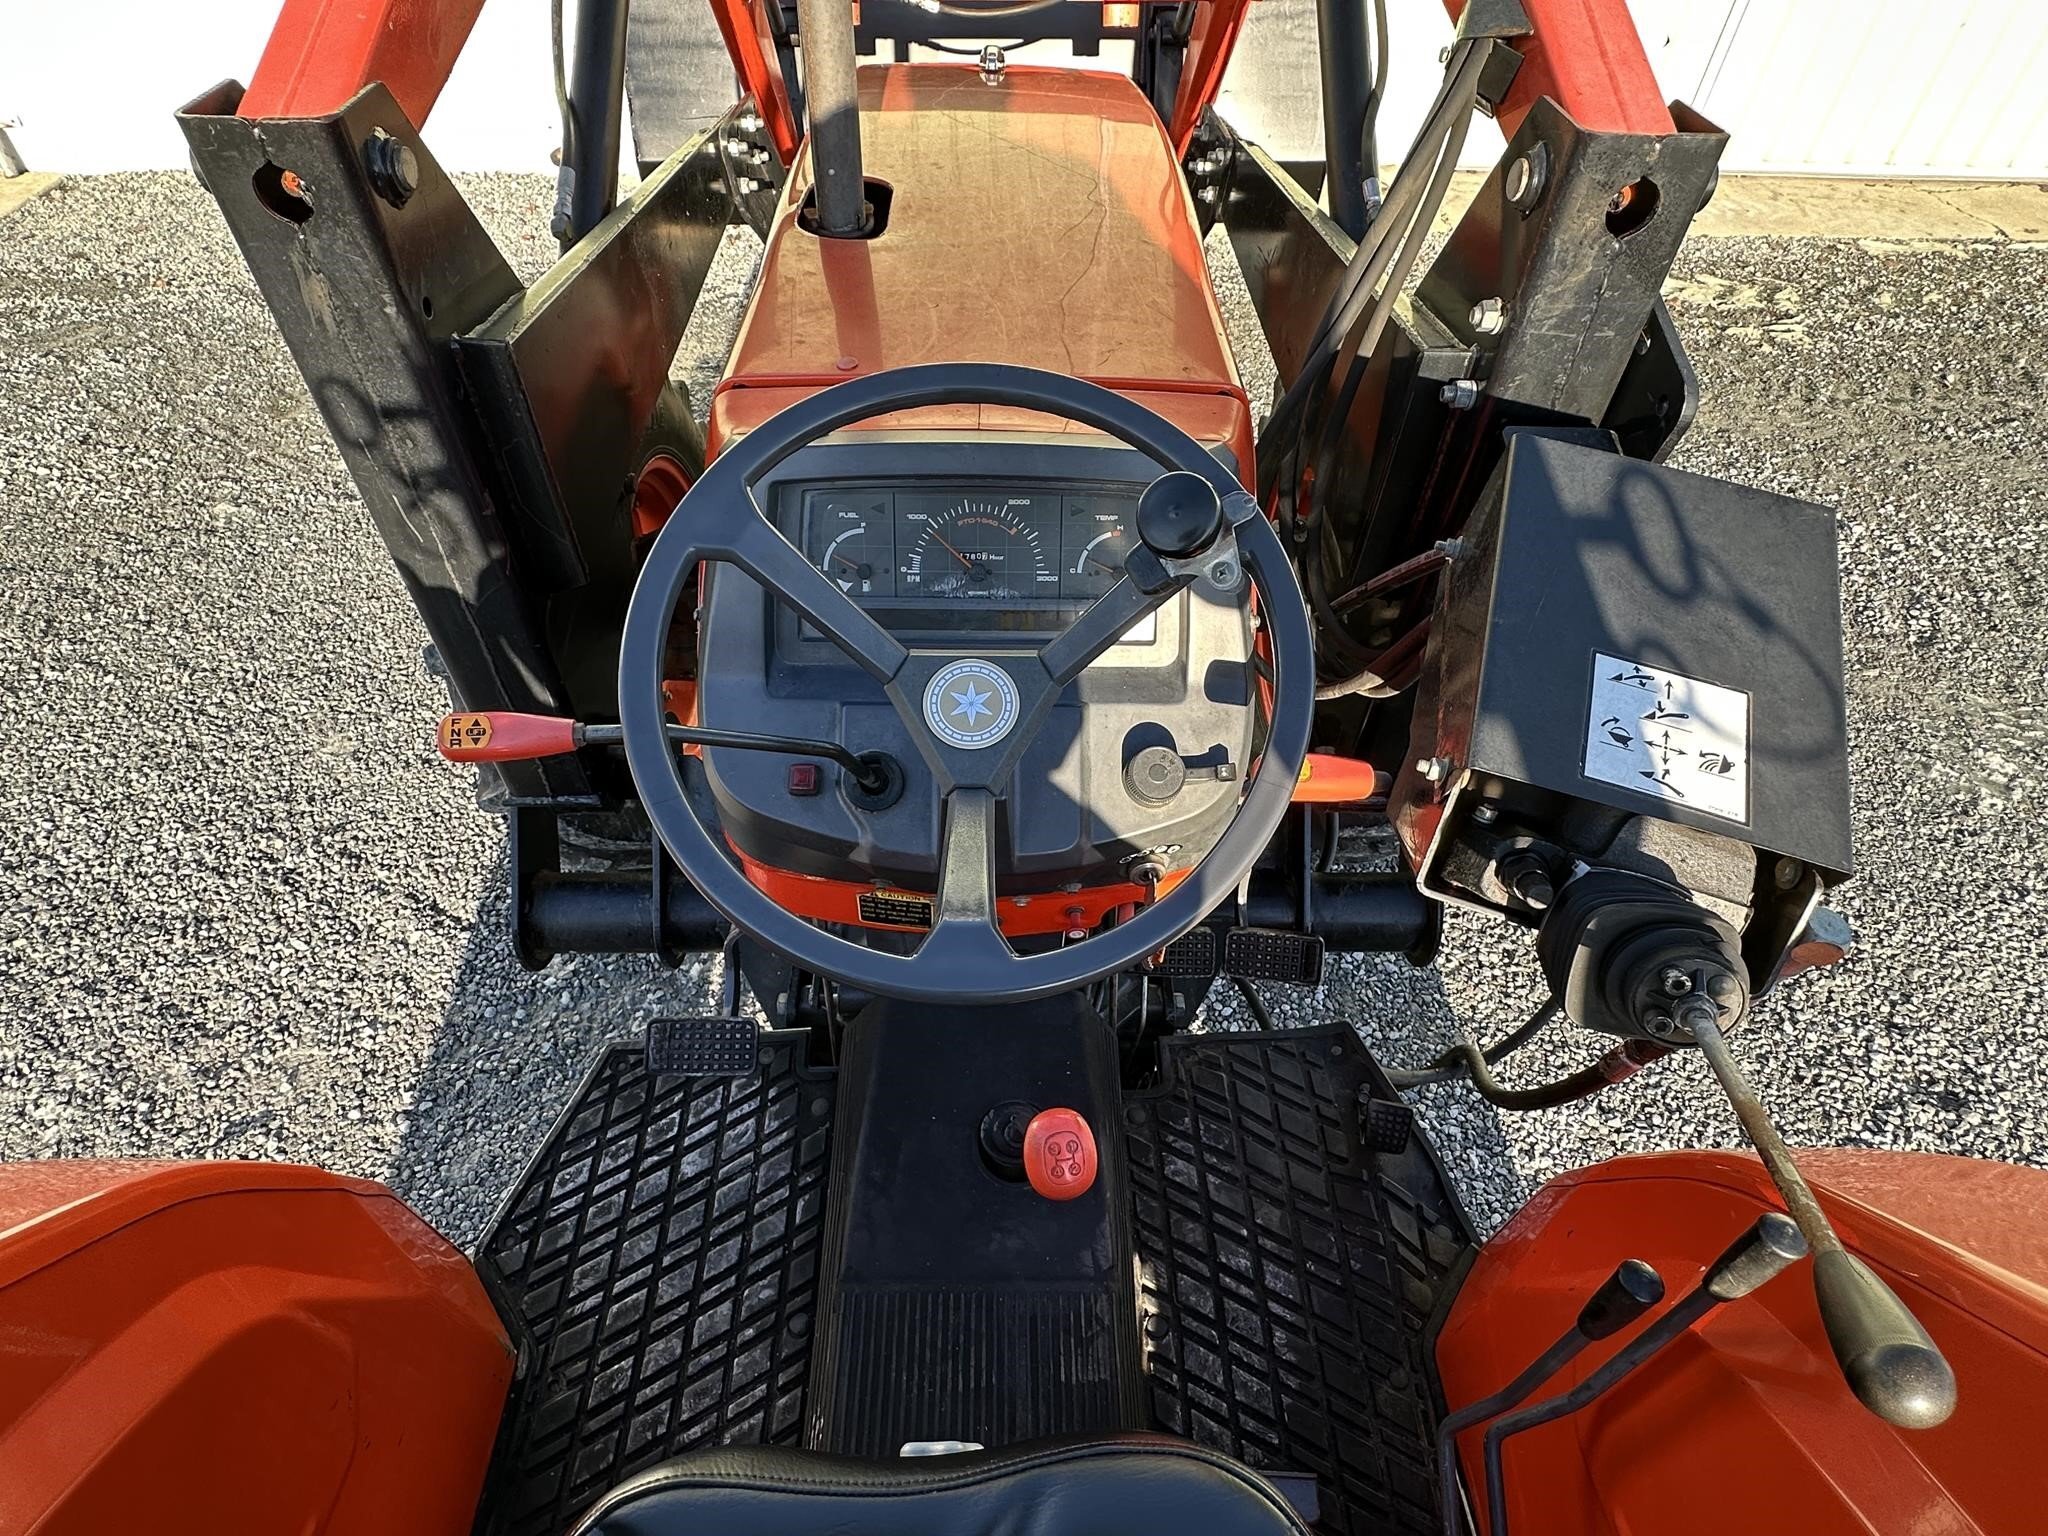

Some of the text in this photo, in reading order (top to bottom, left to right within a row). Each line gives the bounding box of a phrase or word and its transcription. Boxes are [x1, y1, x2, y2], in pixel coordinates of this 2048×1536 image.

[906, 575, 921, 583] RPM
[451, 718, 462, 727] F
[451, 728, 461, 737] N
[450, 738, 462, 748] R
[881, 893, 921, 901] CAUTION
